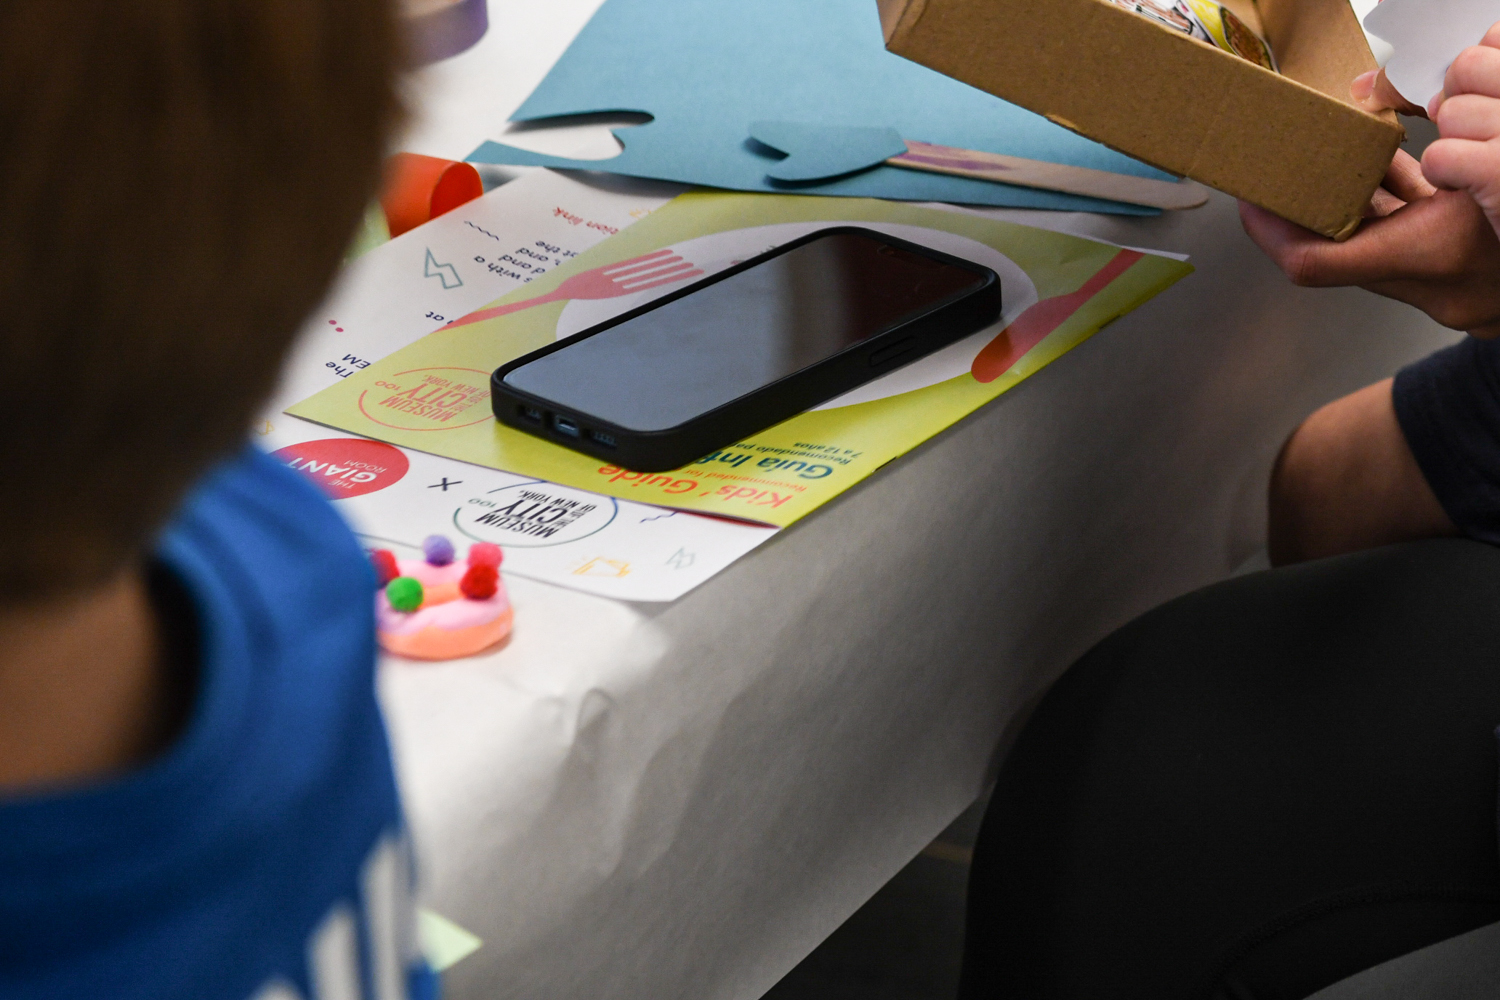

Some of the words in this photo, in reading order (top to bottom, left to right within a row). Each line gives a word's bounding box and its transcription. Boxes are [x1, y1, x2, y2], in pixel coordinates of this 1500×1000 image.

[552, 206, 584, 226] link
[585, 220, 619, 235] tion
[498, 254, 532, 269] and
[514, 247, 549, 262] and
[487, 262, 521, 281] with
[425, 311, 445, 322] at
[325, 361, 354, 378] The
[342, 353, 371, 369] EM
[396, 383, 468, 409] CITY
[378, 395, 458, 422] MUSEUM
[343, 459, 387, 474] ROOM
[696, 450, 753, 468] Inf
[757, 457, 834, 479] Guía
[286, 457, 378, 483] GIANT
[597, 464, 699, 494] Guide
[699, 484, 794, 509] Kids'
[494, 499, 568, 524] CITY
[473, 511, 560, 539] MUSEUM
